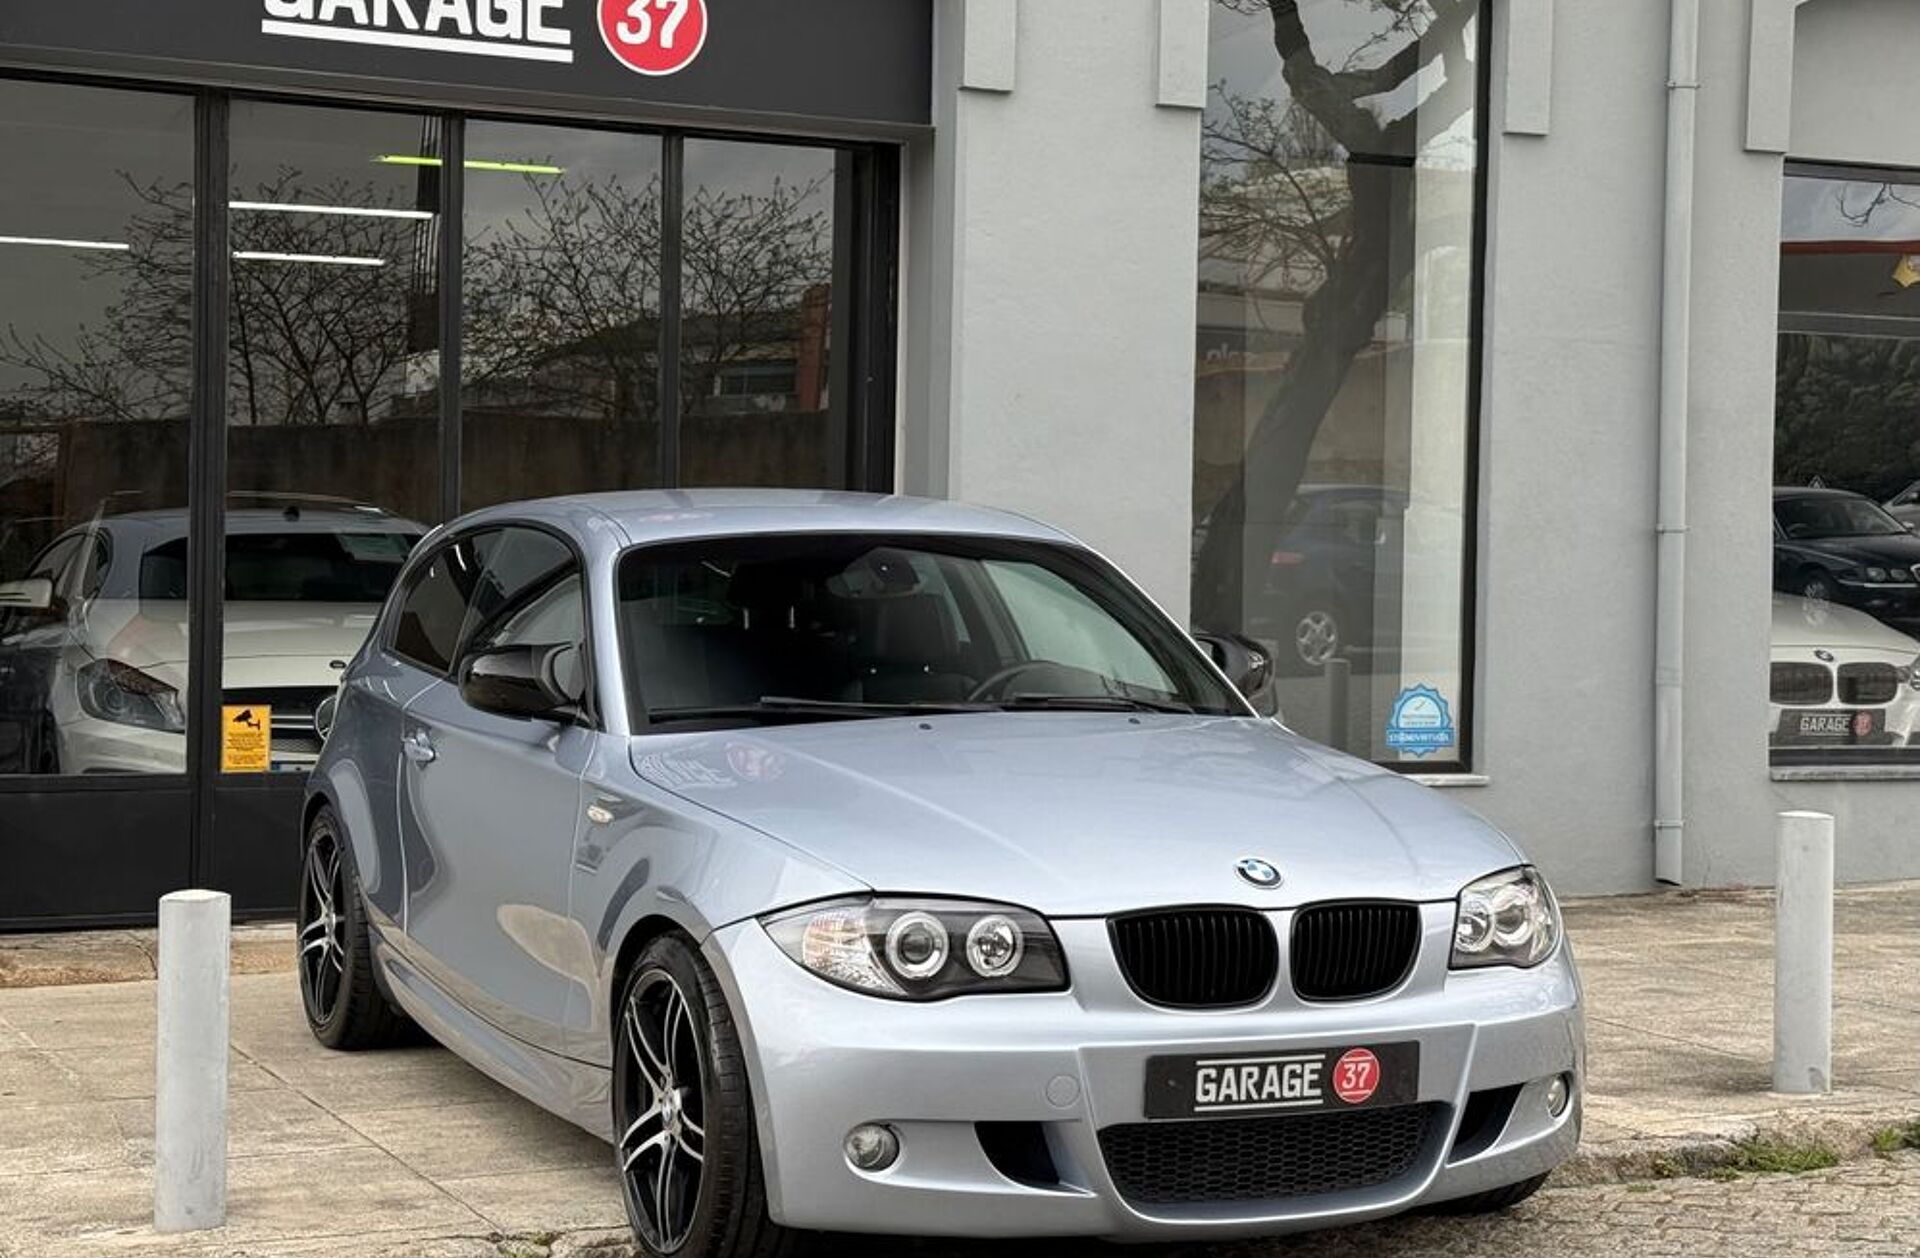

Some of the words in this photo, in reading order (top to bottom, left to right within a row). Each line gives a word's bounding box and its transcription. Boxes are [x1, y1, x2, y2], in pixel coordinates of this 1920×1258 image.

[616, 0, 689, 48] 37
[1800, 717, 1851, 732] GARAGE
[1196, 1062, 1322, 1103] GARAGE
[1342, 1062, 1371, 1090] 37
